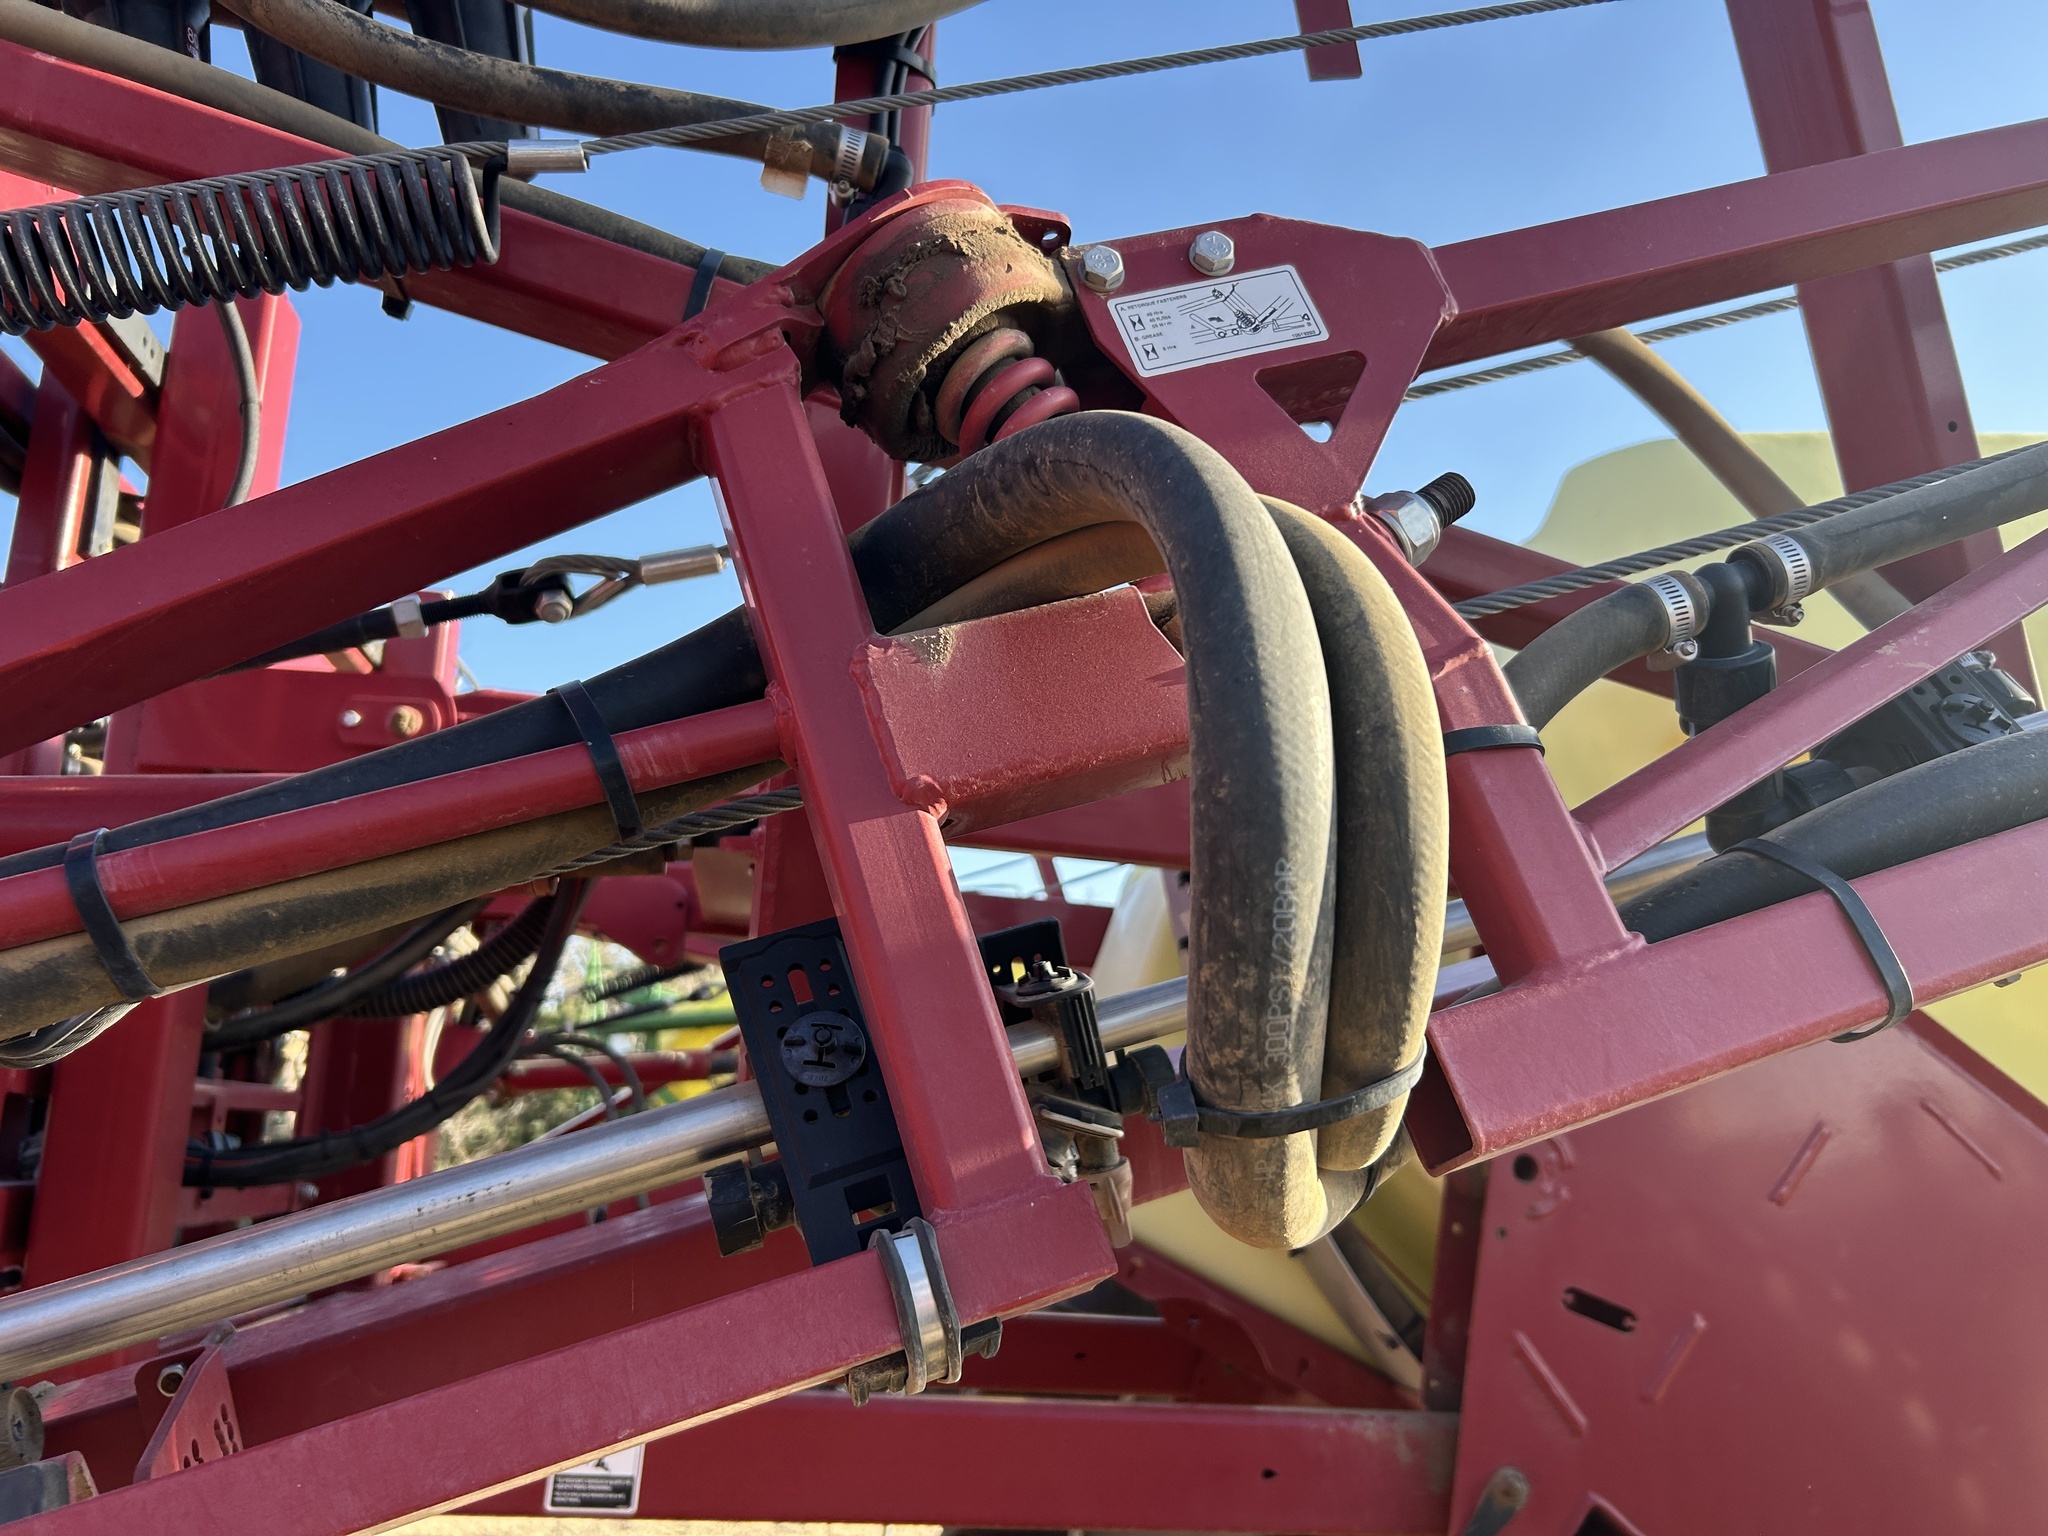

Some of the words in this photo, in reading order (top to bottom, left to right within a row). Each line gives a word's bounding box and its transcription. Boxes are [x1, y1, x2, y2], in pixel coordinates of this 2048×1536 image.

[1126, 300, 1156, 310] RETORQUE
[1156, 293, 1188, 304] FASTENERS
[1140, 331, 1164, 340] GREASE
[1264, 856, 1298, 1069] 300PSI/20BAR
